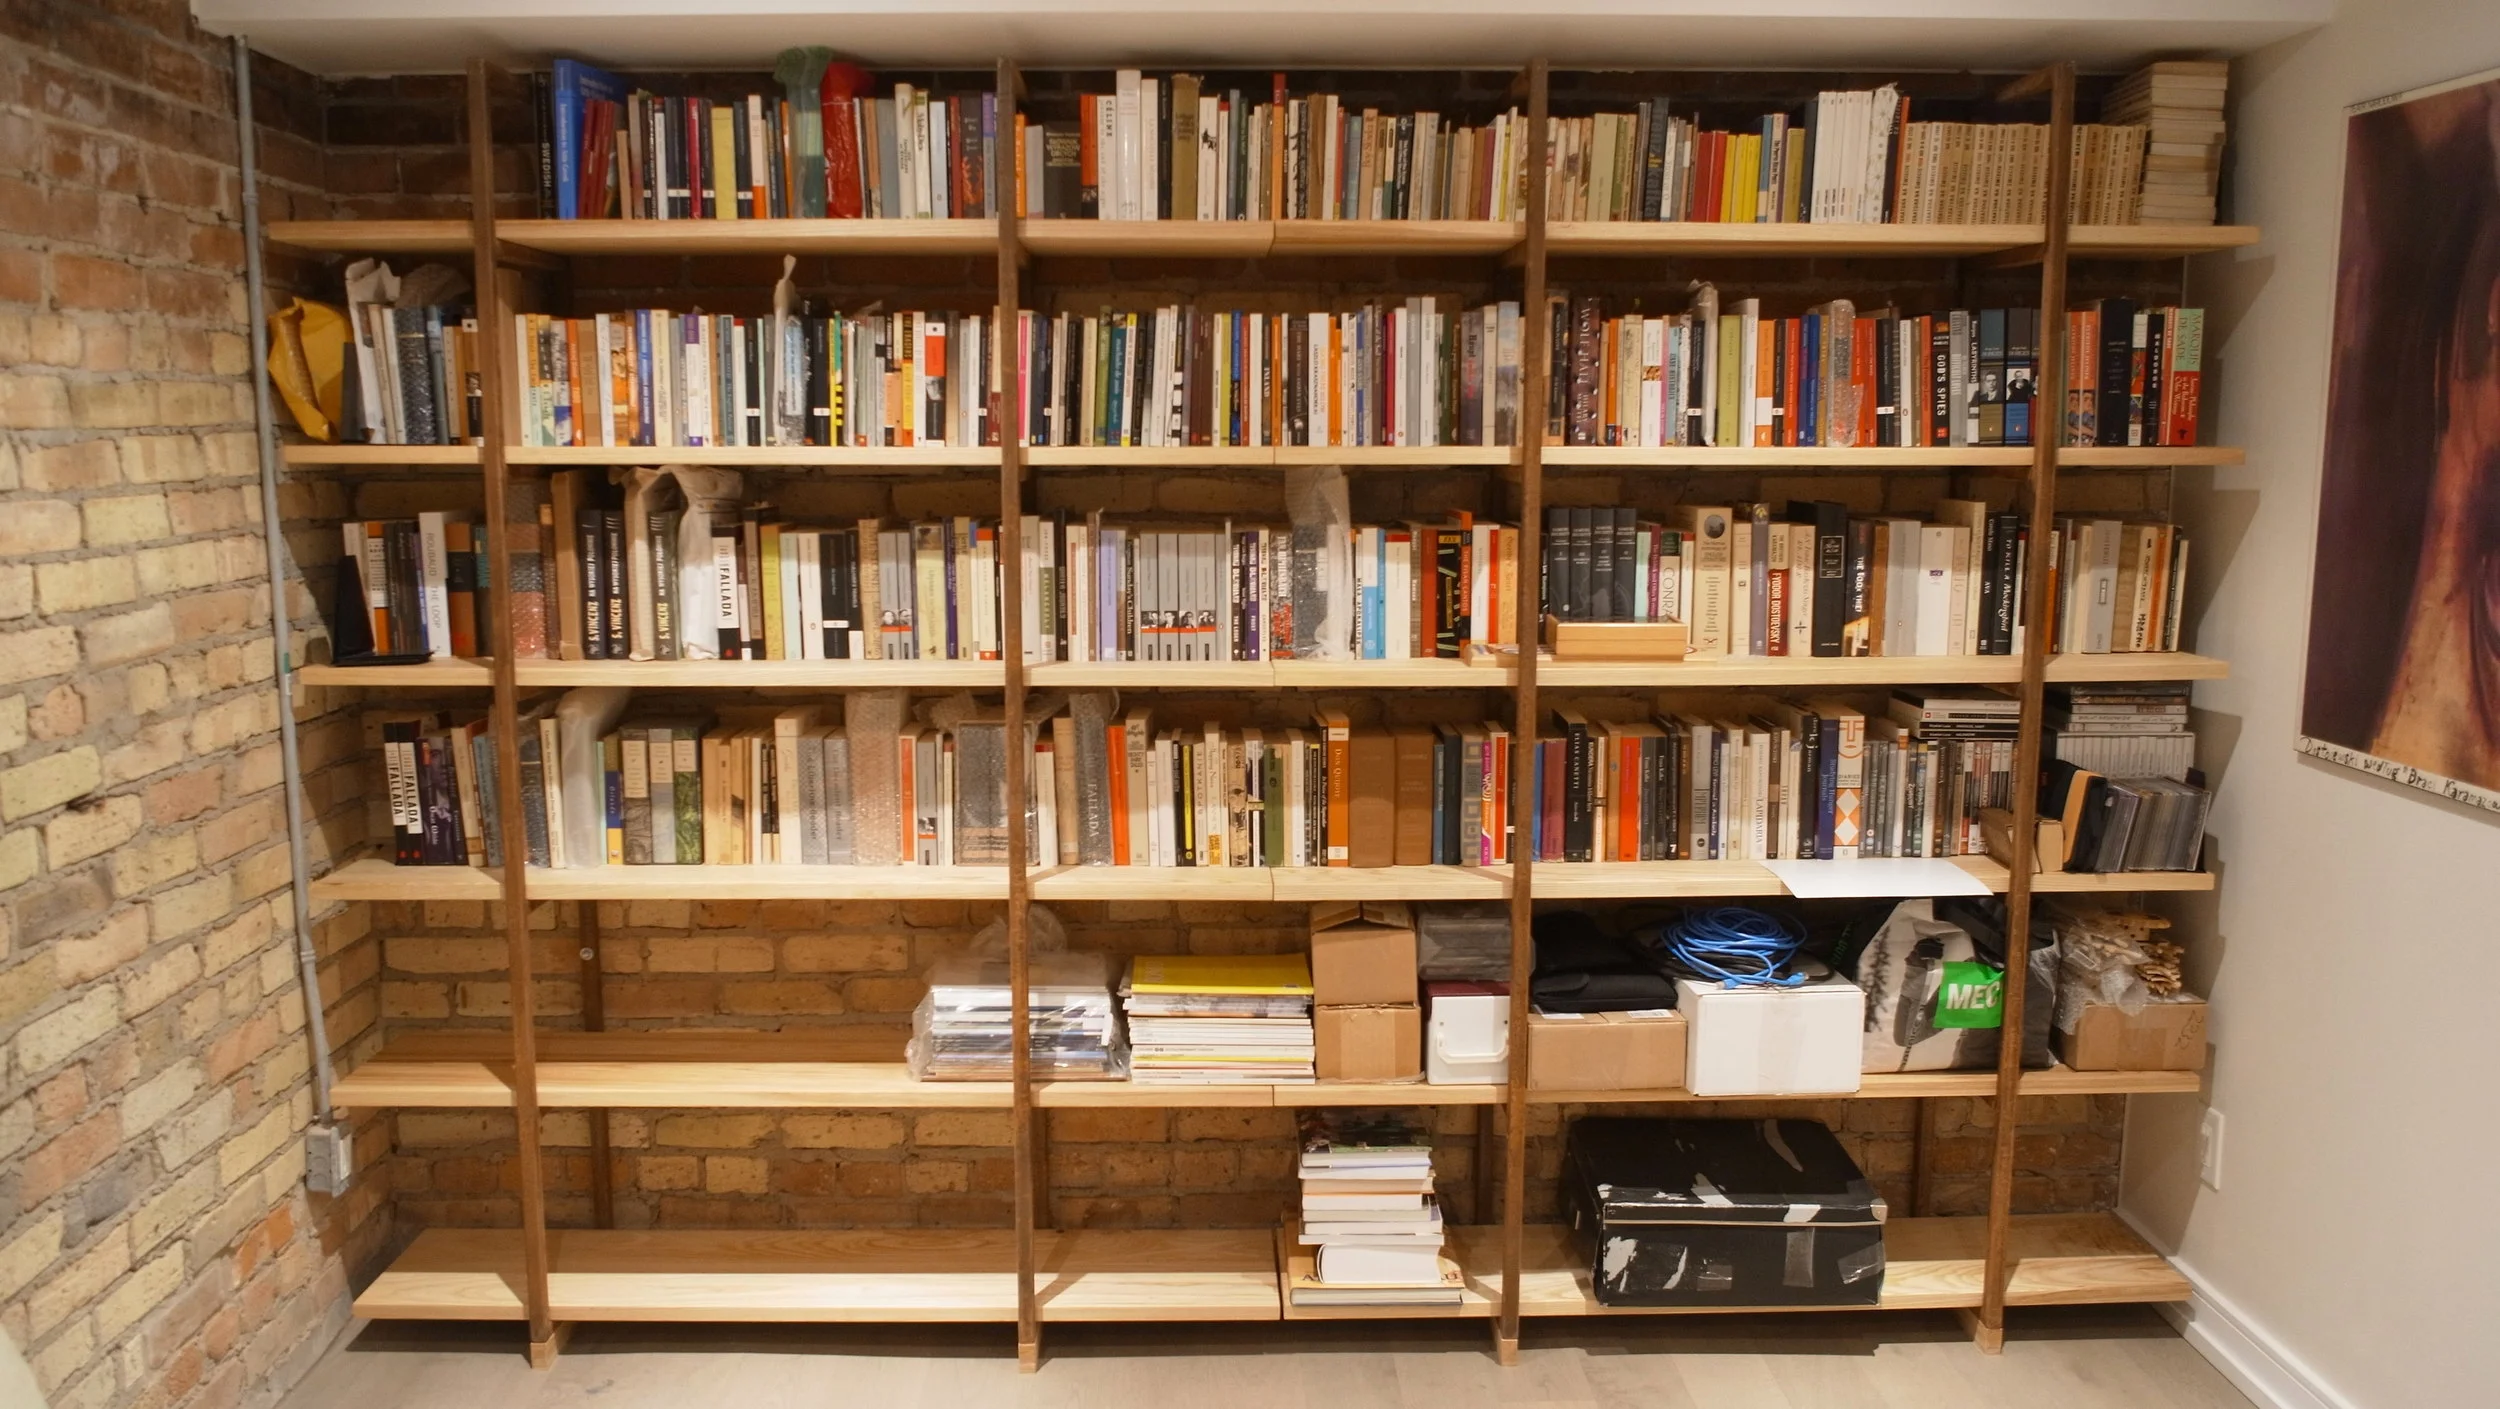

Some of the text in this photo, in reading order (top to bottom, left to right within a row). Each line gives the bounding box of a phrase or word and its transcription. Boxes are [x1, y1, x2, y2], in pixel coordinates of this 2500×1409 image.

[541, 142, 553, 188] SWEDISH
[1578, 308, 1591, 384] WOLF HALL
[2176, 317, 2188, 362] DE SADE
[2190, 313, 2202, 365] MARQUIS
[1936, 354, 1947, 416] GOD'S SPIES
[720, 567, 732, 617] FALLADA
[1125, 566, 1134, 601] Sunday's
[1662, 567, 1675, 616] CONRA
[1983, 581, 1991, 594] AVA
[432, 605, 441, 628] LOOP
[587, 600, 600, 635] VINCENZ
[610, 598, 623, 631] VINCENZ
[656, 602, 669, 632] VINCENZ
[1770, 572, 1781, 643] FYODOR DOSTOEVSKY
[1998, 583, 2011, 632] Mockingbird
[1805, 744, 1818, 773] jarman
[1828, 759, 1837, 788] Studying
[389, 766, 404, 815] FALLADA
[406, 775, 419, 824] FALLADA
[1821, 774, 1829, 801] Journals
[809, 811, 818, 839] Reader
[1087, 783, 1100, 838] FALLADA
[1669, 843, 1677, 853] 7
[1945, 981, 2001, 1010] MEC
